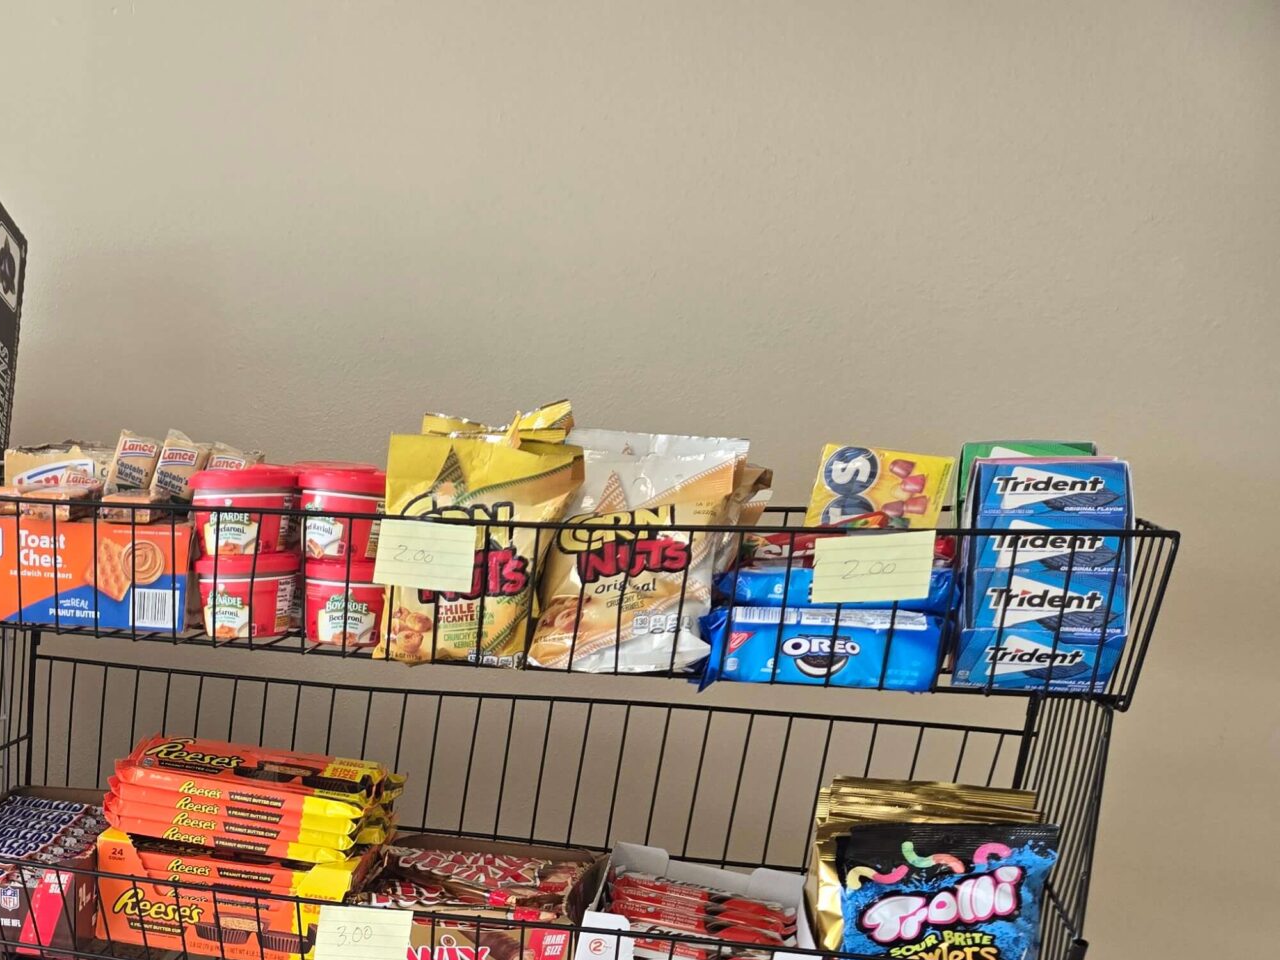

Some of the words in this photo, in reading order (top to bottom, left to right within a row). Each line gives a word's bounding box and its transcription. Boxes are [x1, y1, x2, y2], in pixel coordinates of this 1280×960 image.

[122, 440, 155, 453] Lance
[163, 449, 195, 462] Lance
[995, 476, 1104, 492] Trident
[18, 531, 65, 549] Toast
[993, 535, 1103, 549] Trident
[20, 549, 63, 568] Chee
[394, 544, 433, 564] 2.00
[577, 538, 691, 583] NUTS
[70, 598, 88, 609] REAL
[325, 601, 368, 614] BOYARDEE
[990, 588, 1102, 609] Trident
[438, 603, 475, 615] CHILE
[782, 637, 861, 657] OREO
[987, 647, 1083, 664] Trident
[146, 742, 246, 770] Reese's
[332, 767, 359, 775] KING
[179, 781, 223, 800] Reese's
[176, 797, 219, 815] Reese's
[172, 812, 216, 830] Reese's
[111, 847, 123, 857] 24
[113, 887, 204, 923] Reese's
[863, 866, 1022, 943] Trolli
[336, 927, 373, 946] 3.00
[543, 934, 566, 945] SHARE
[890, 934, 938, 958] SOUR
[942, 930, 993, 945] BRITE
[544, 945, 562, 956] SIZE
